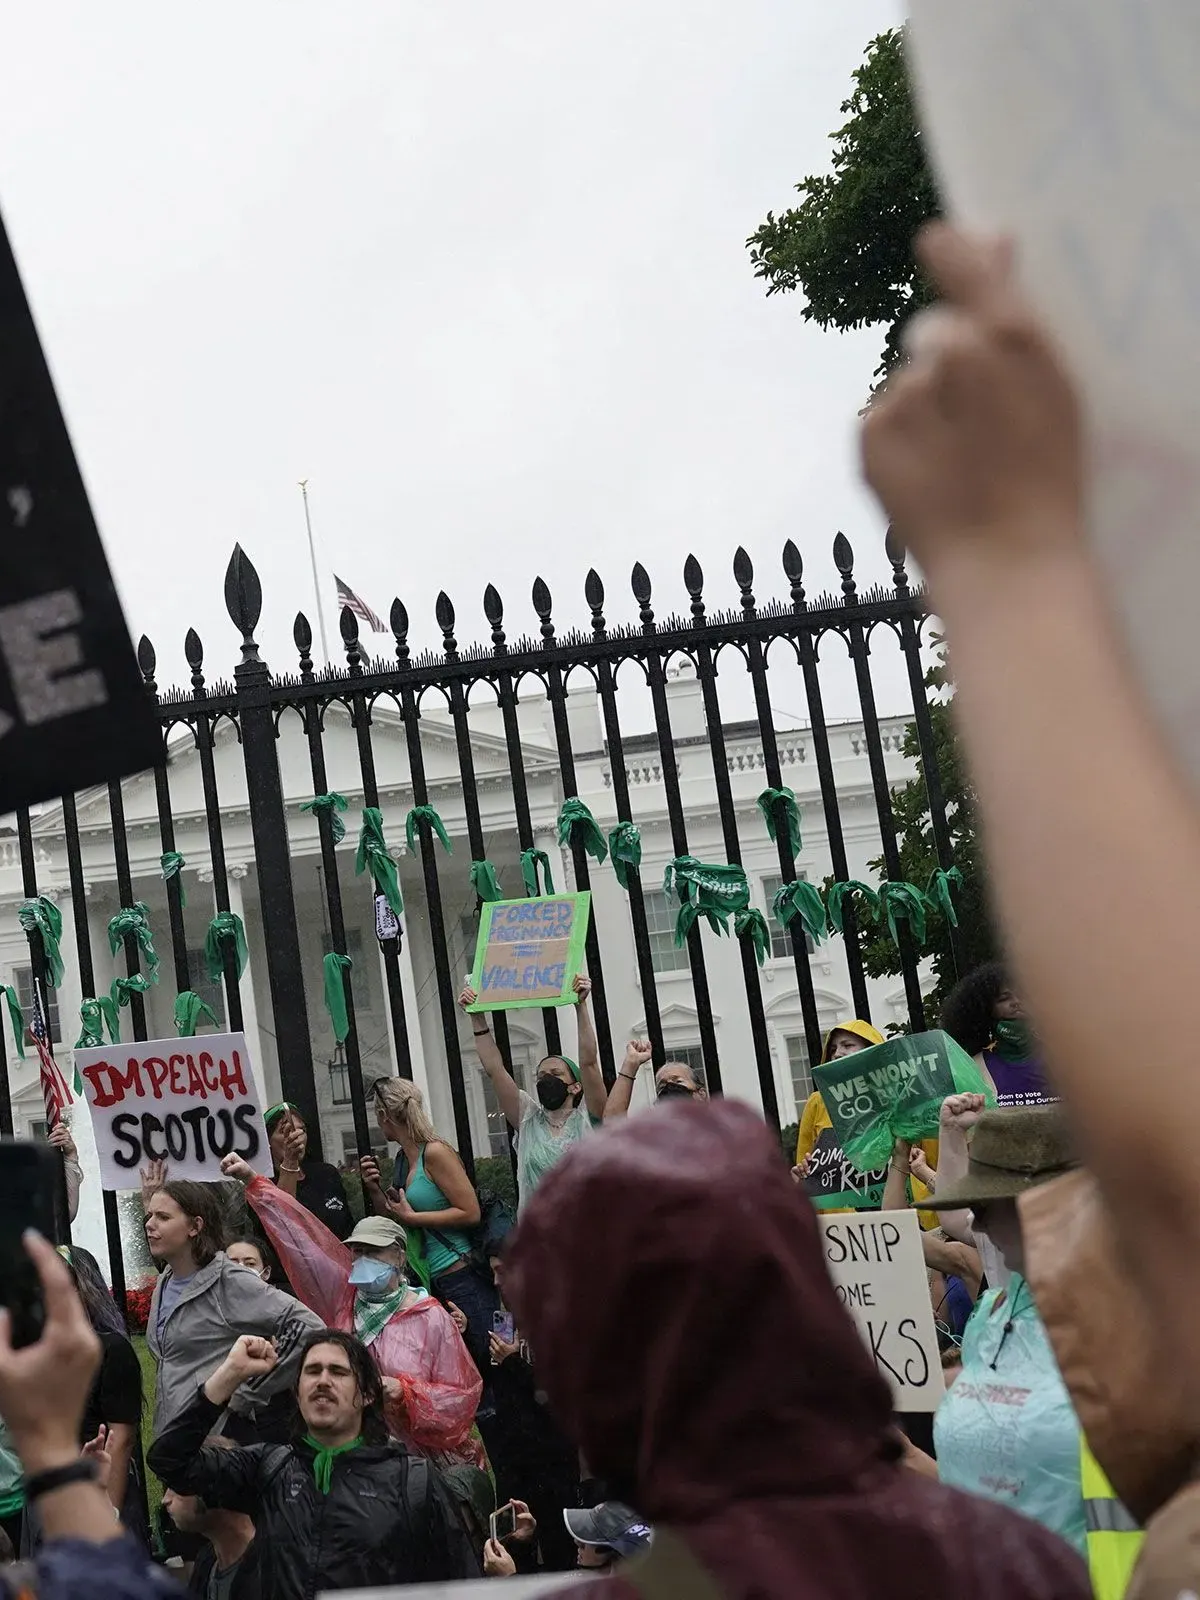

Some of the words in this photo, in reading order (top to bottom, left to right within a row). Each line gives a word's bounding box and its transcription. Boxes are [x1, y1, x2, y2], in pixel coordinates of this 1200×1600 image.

[491, 903, 572, 925] FORCED
[488, 921, 572, 944] PREGNANCY
[481, 963, 567, 991] VIOLENCE
[83, 1050, 248, 1107] IMPEACH
[828, 1075, 870, 1103] WE
[868, 1053, 939, 1087] WON'T
[838, 1095, 873, 1120] GO
[111, 1104, 259, 1168] SCOTUS
[821, 1168, 837, 1188] OF
[826, 1222, 900, 1263] SNIP
[834, 1283, 876, 1306] OME
